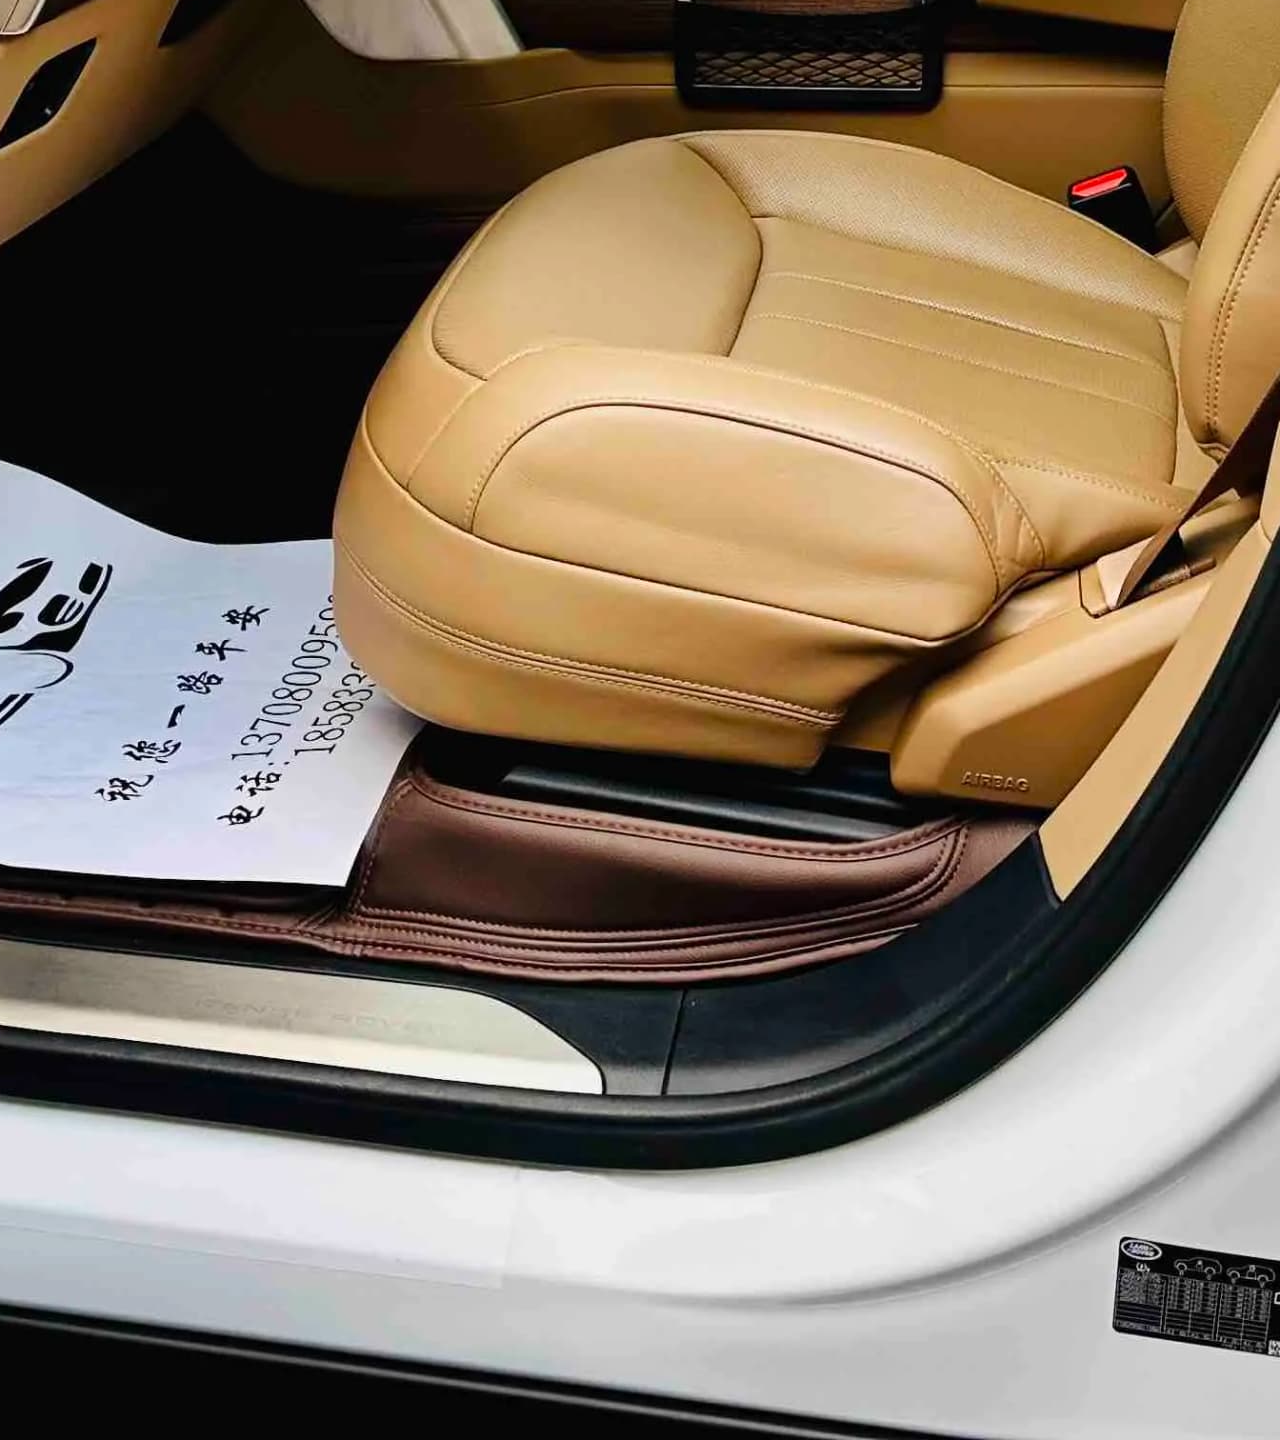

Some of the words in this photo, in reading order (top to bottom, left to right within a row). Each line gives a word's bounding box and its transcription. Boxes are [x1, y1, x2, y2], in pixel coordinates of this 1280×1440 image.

[94, 604, 271, 801] 祝您一路平安
[961, 771, 1030, 792] AIRBAG
